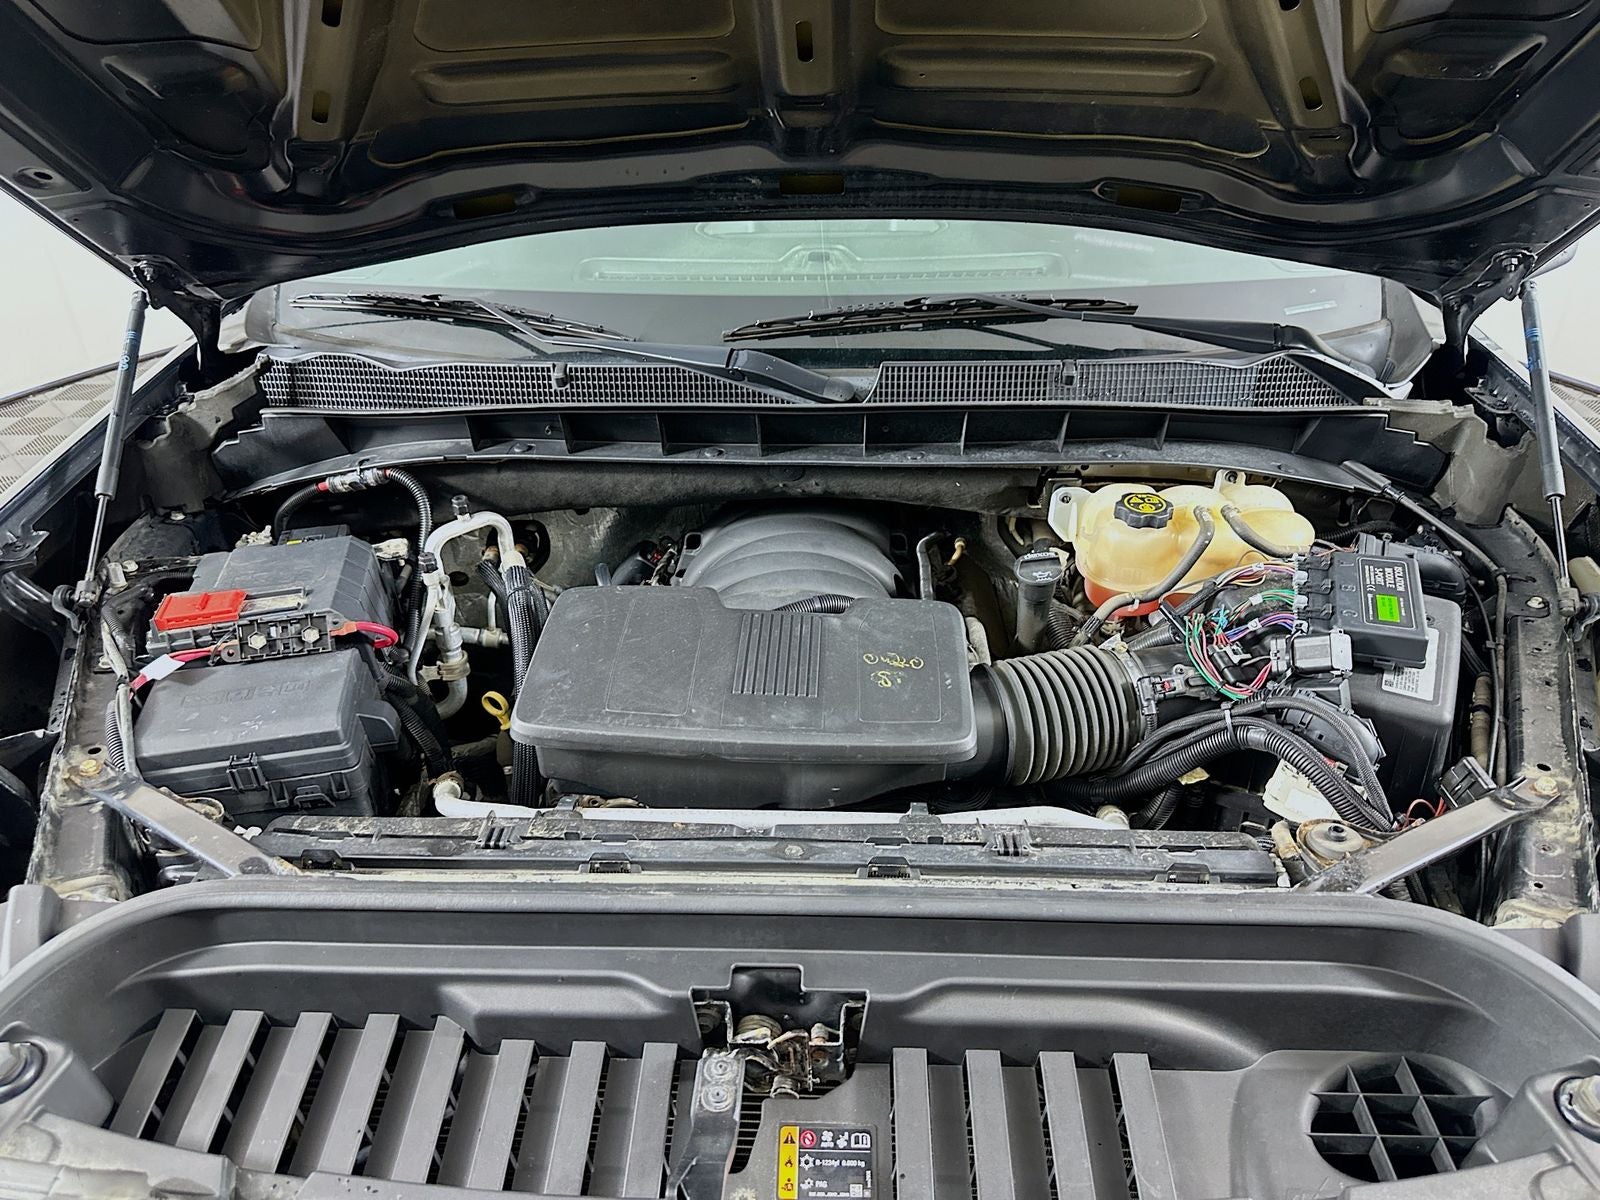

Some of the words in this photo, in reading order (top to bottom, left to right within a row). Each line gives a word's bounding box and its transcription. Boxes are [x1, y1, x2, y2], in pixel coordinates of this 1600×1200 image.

[1374, 567, 1385, 586] 3-PORT
[1384, 567, 1395, 589] MODULE
[1394, 566, 1405, 592] ISOLATION
[857, 1159, 866, 1168] kg
